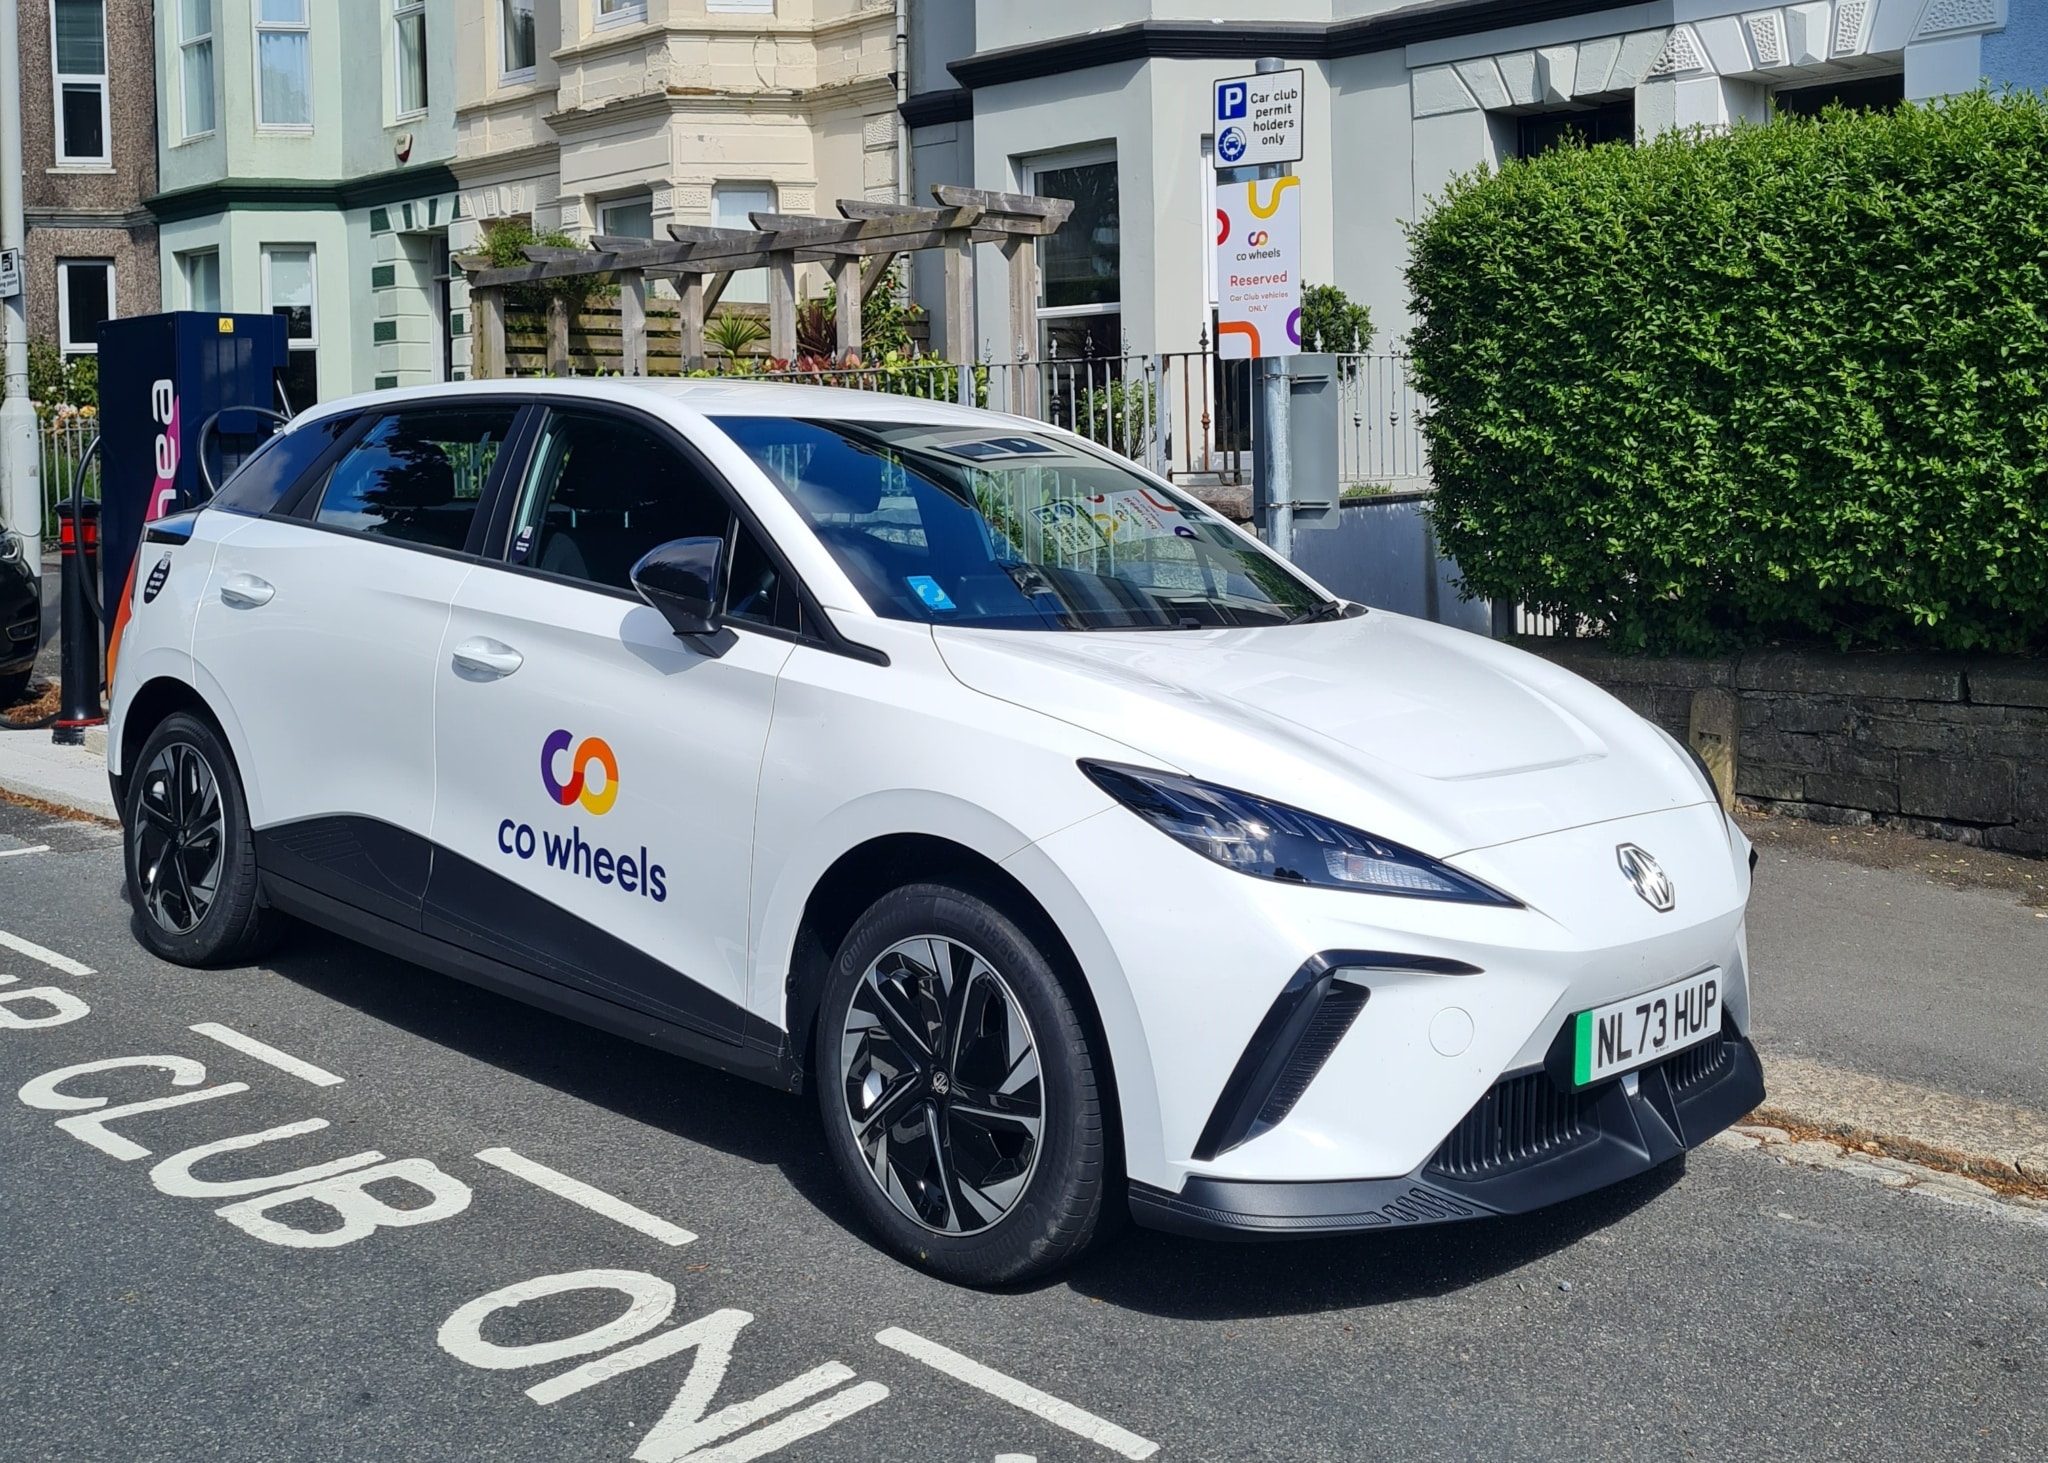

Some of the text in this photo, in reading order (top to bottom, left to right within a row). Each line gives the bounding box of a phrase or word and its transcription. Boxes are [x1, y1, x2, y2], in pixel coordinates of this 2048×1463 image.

[1225, 86, 1243, 117] P
[1250, 88, 1298, 104] Car club
[1255, 103, 1292, 119] permit
[1253, 119, 1294, 132] holders
[1262, 133, 1286, 146] only
[1236, 248, 1281, 261] co wheels
[1230, 270, 1288, 287] Reserved
[1243, 293, 1260, 301] Club
[1260, 291, 1289, 300] vehicles
[1248, 304, 1268, 313] ONLY
[498, 818, 668, 903] co wheels
[1597, 979, 1717, 1069] NL73 HUP
[18, 1054, 473, 1250] CLUB
